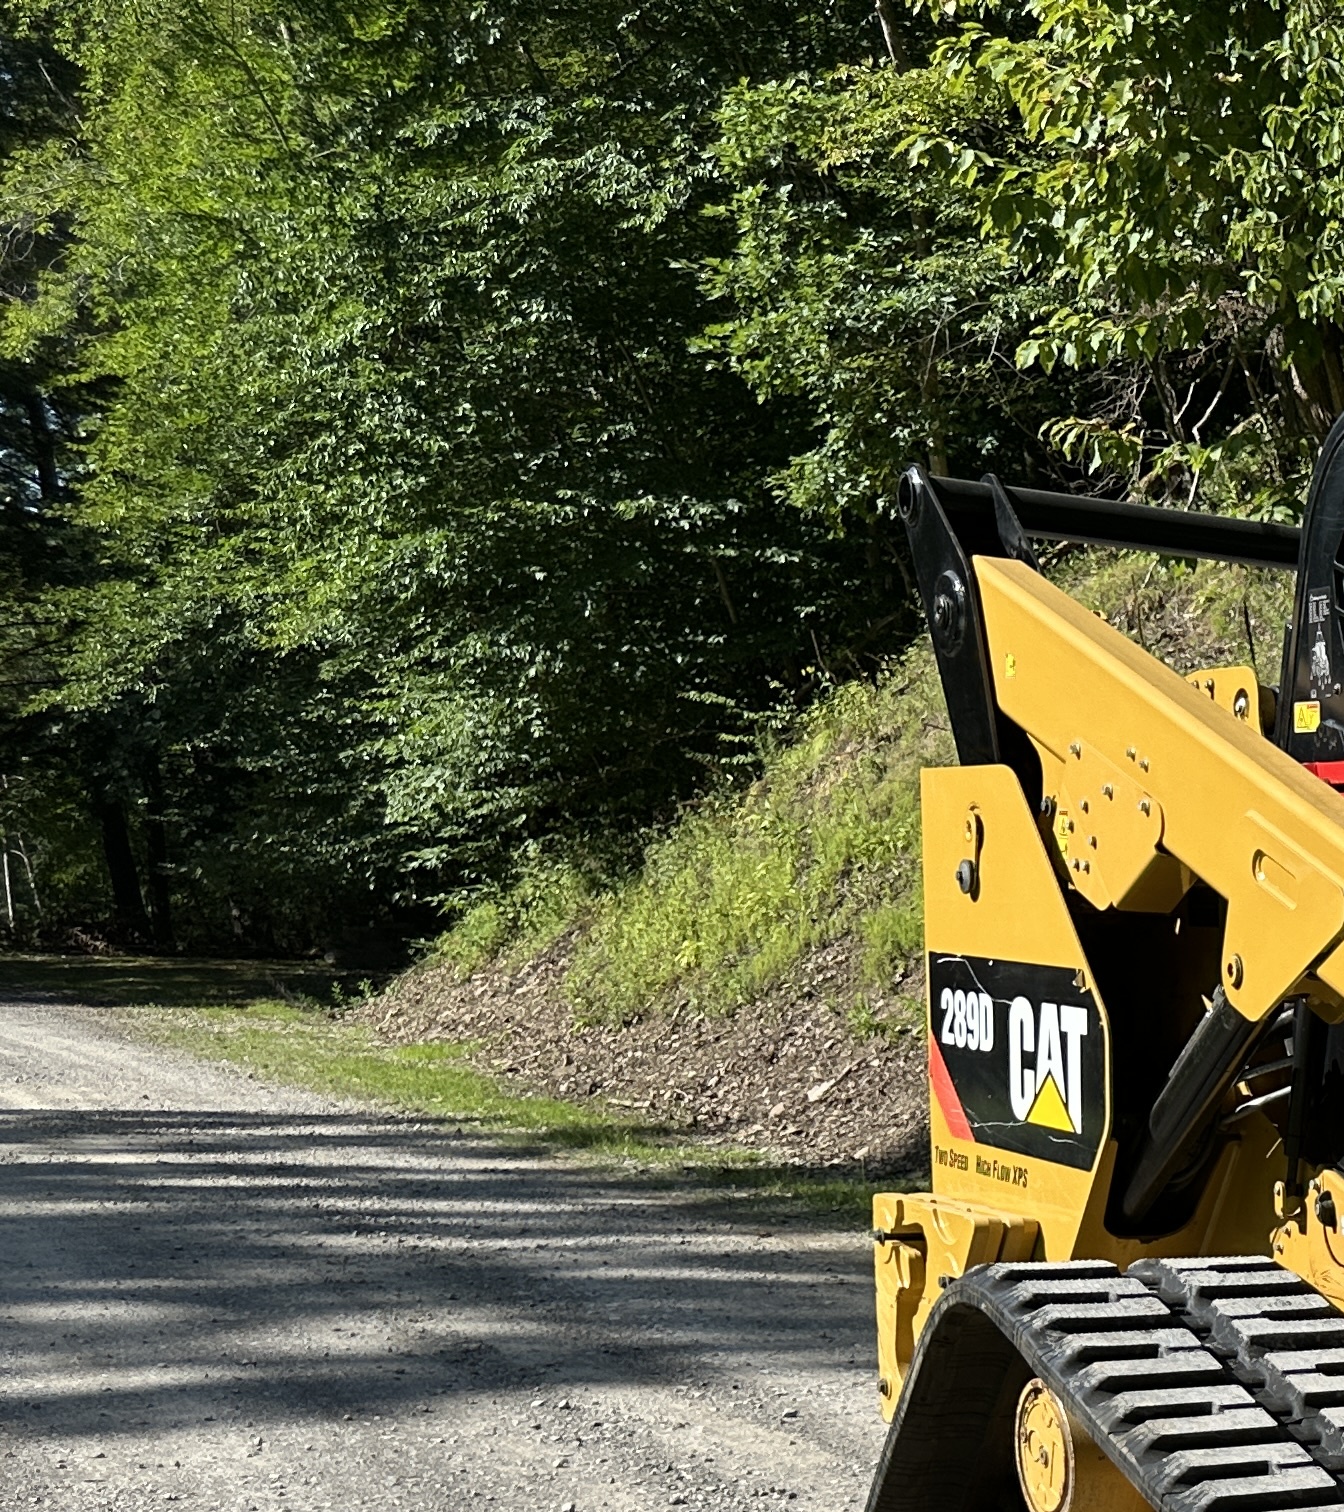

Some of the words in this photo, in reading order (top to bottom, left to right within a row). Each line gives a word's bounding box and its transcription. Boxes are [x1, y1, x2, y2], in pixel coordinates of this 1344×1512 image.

[940, 987, 994, 1052] 289D
[1009, 996, 1088, 1134] CAT
[1012, 1165, 1028, 1188] XPS
